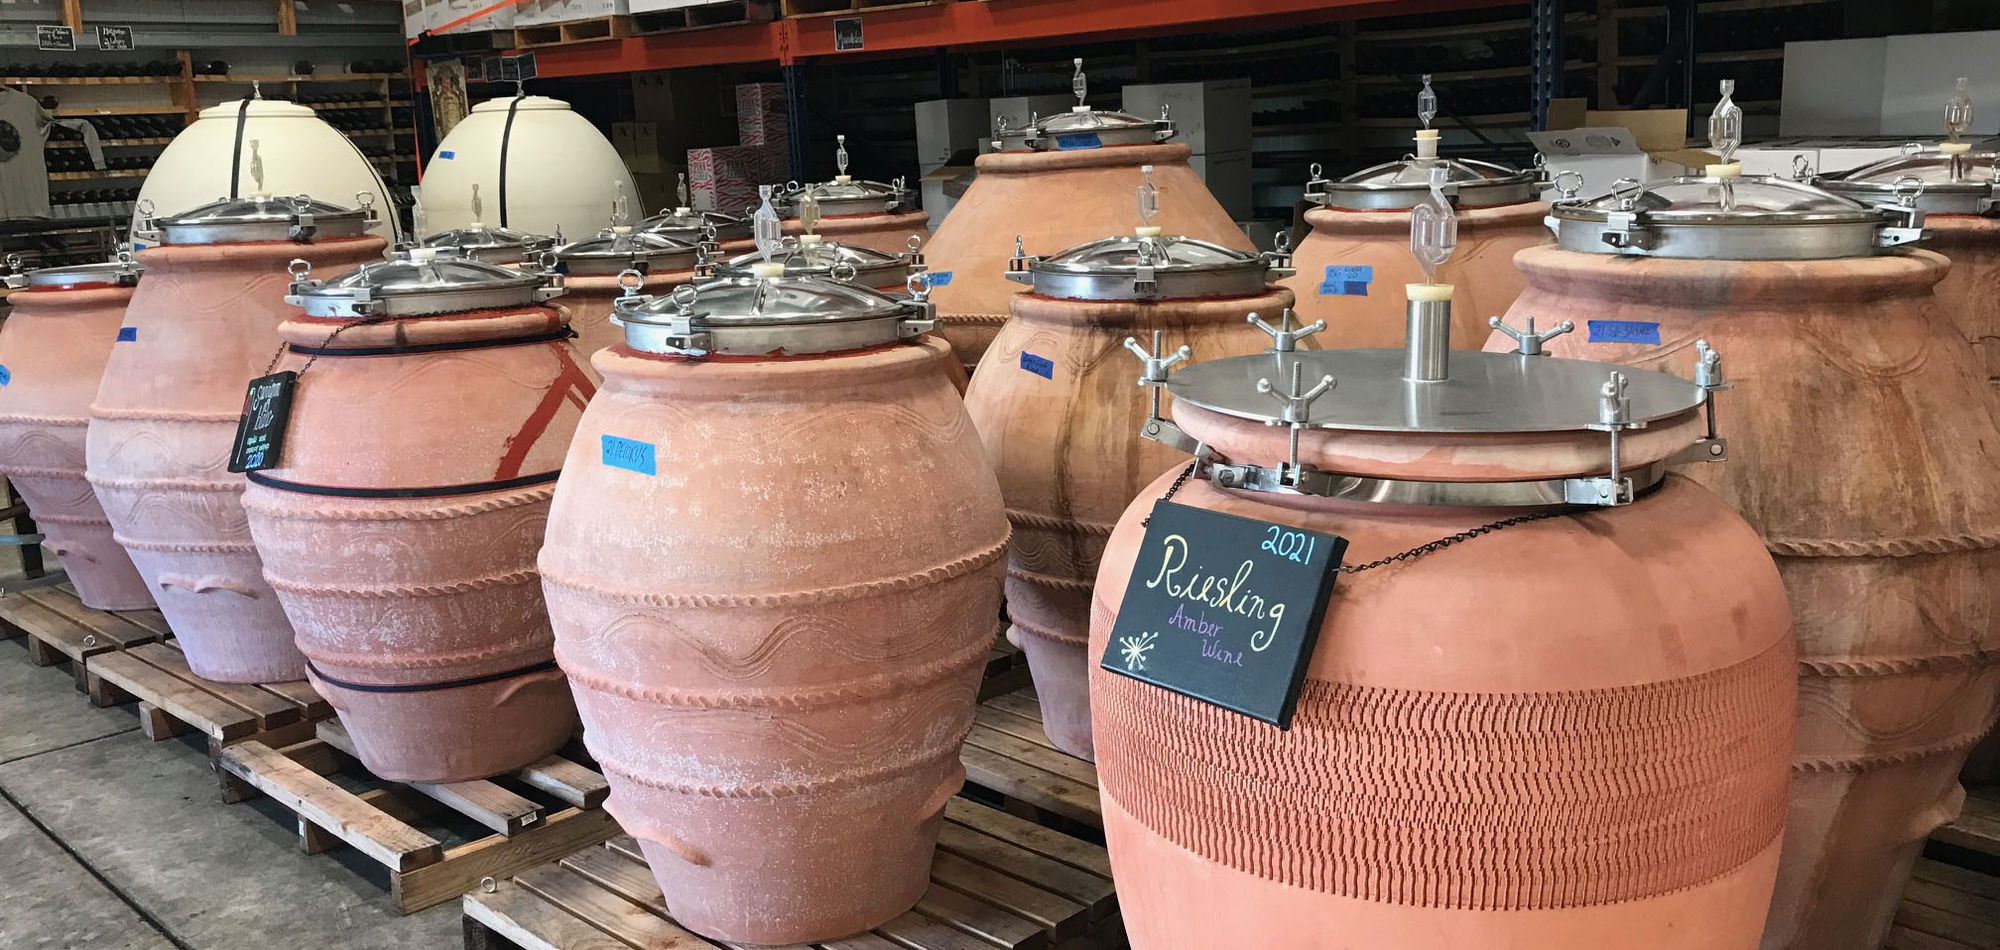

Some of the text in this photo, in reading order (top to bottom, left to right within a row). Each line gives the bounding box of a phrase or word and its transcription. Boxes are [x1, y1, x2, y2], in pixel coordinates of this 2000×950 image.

[245, 451, 264, 469] 2020
[1261, 525, 1315, 565] 2021
[1146, 534, 1286, 652] Riesling
[1168, 602, 1224, 637] Amber
[1201, 639, 1246, 667] Wine
